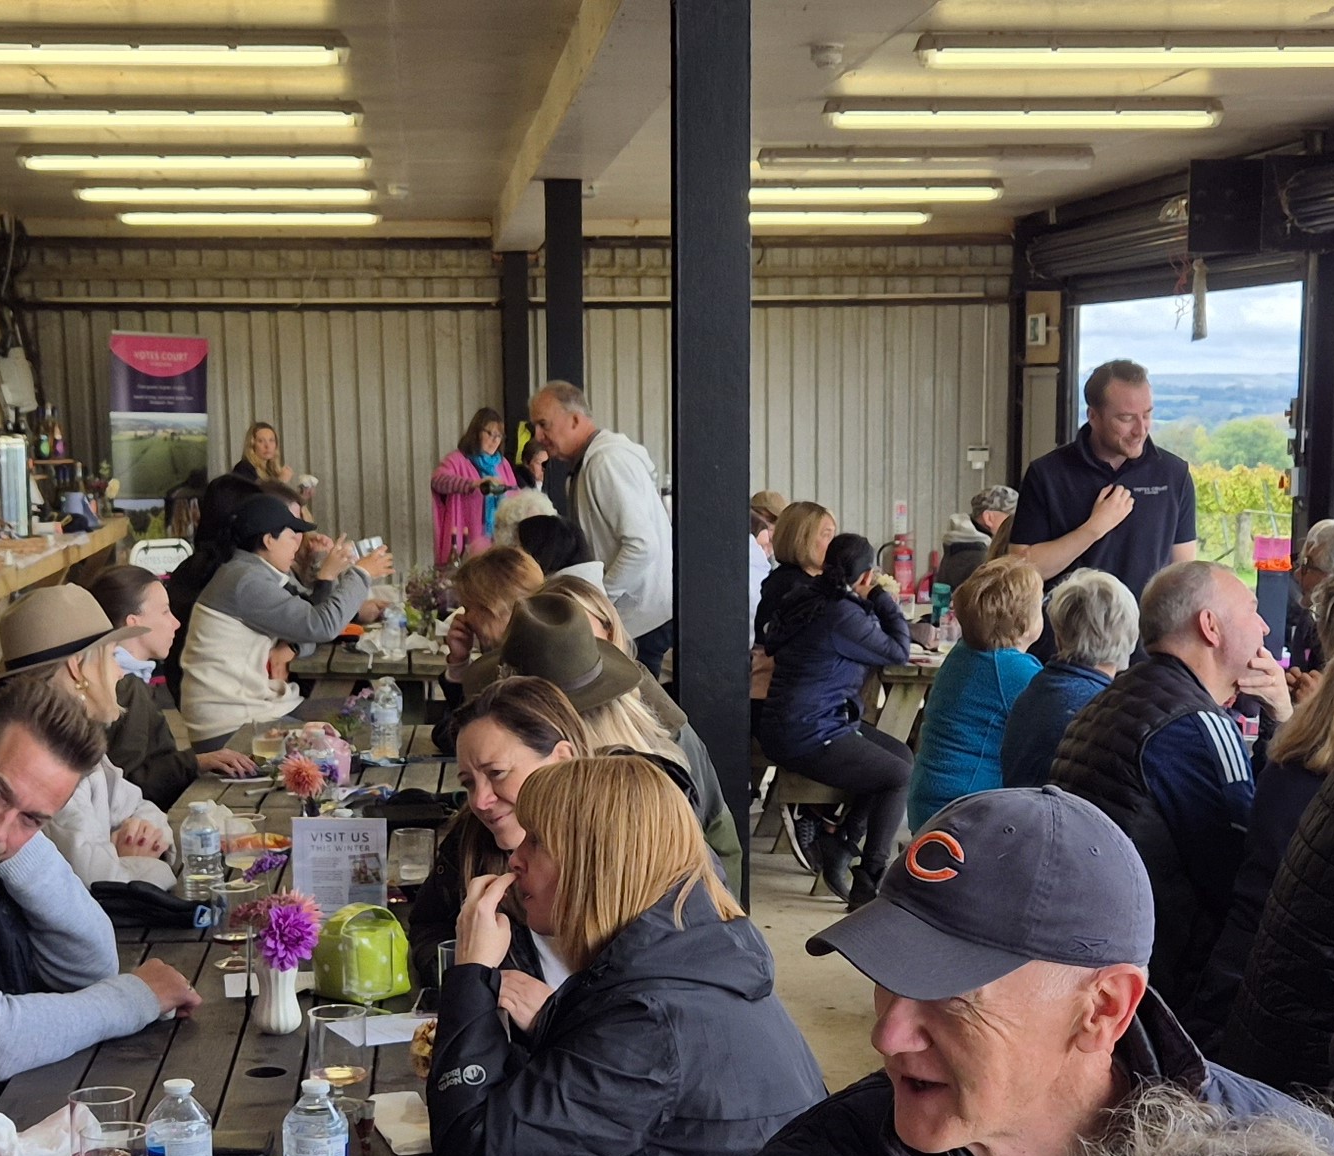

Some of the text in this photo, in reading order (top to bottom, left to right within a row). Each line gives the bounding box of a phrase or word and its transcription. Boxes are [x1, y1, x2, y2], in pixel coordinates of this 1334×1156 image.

[311, 832, 370, 842] VISIT US
[310, 844, 370, 852] THIS WINTER
[905, 829, 965, 883] C
